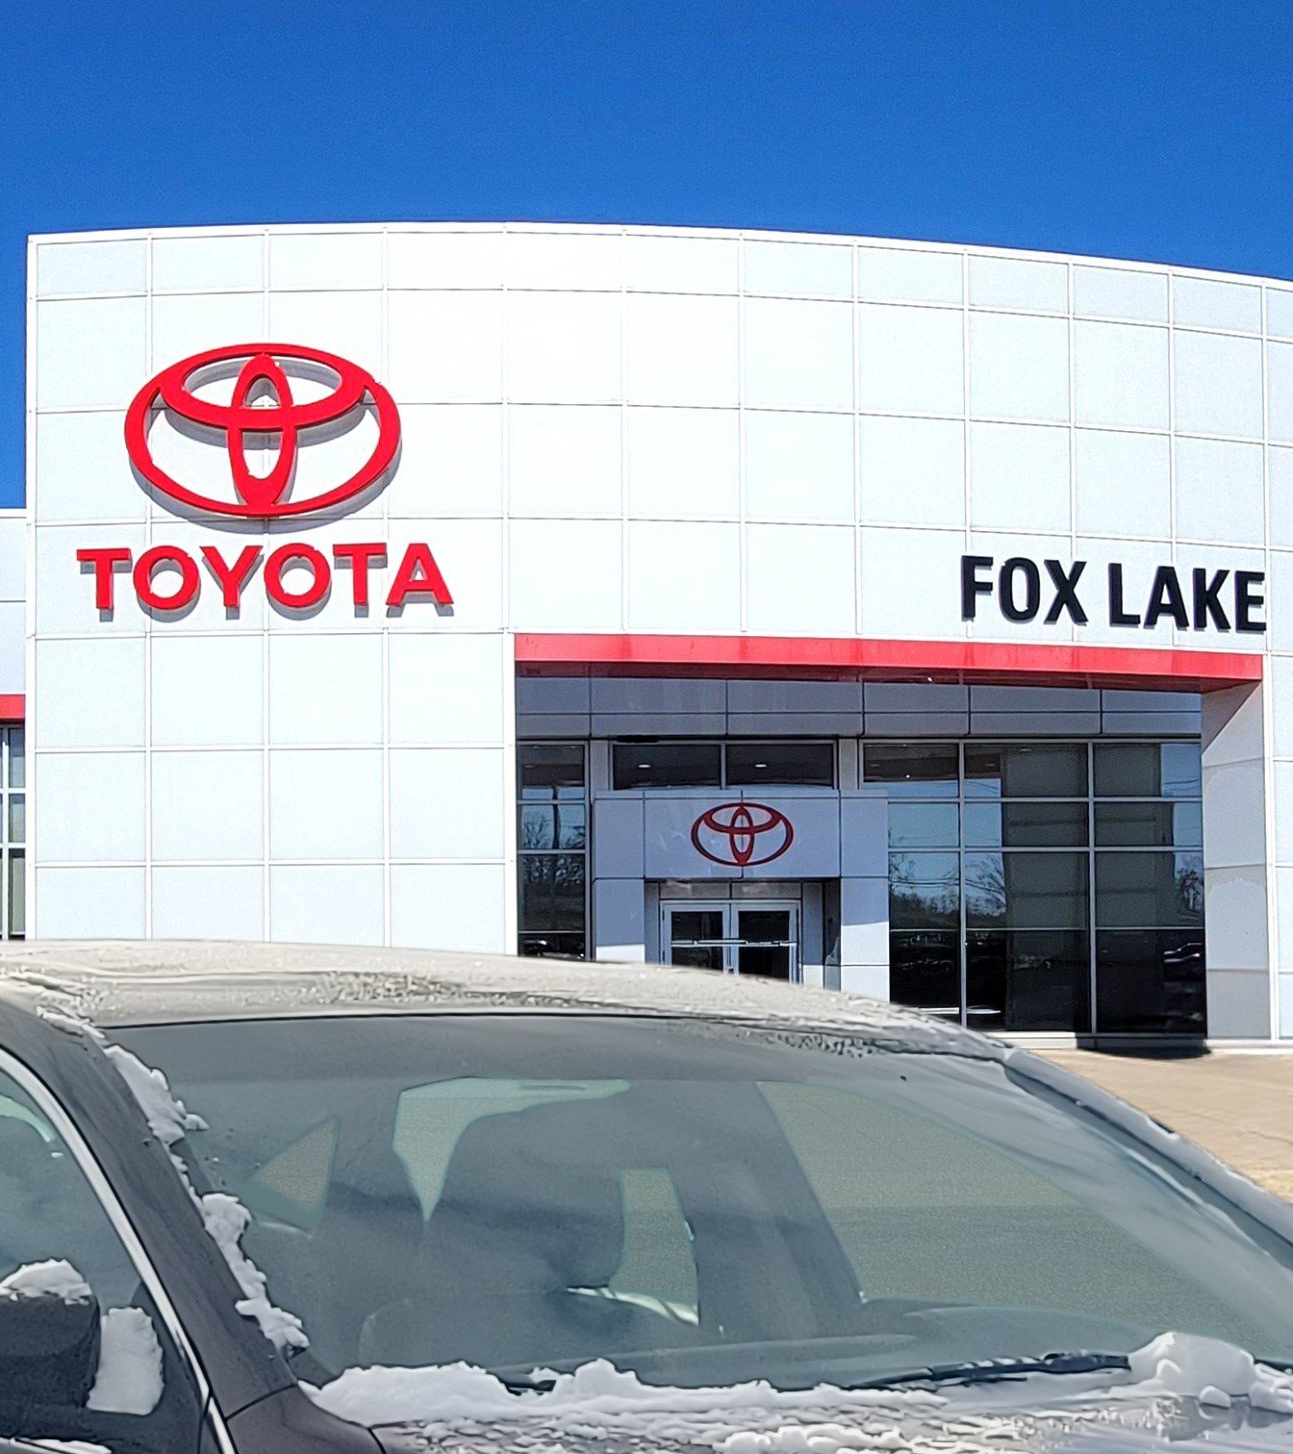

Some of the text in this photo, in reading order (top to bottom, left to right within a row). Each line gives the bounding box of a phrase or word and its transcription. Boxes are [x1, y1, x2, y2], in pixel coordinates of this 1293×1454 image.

[77, 543, 455, 612] TOYOTA
[961, 555, 1267, 632] FOX LAKE
